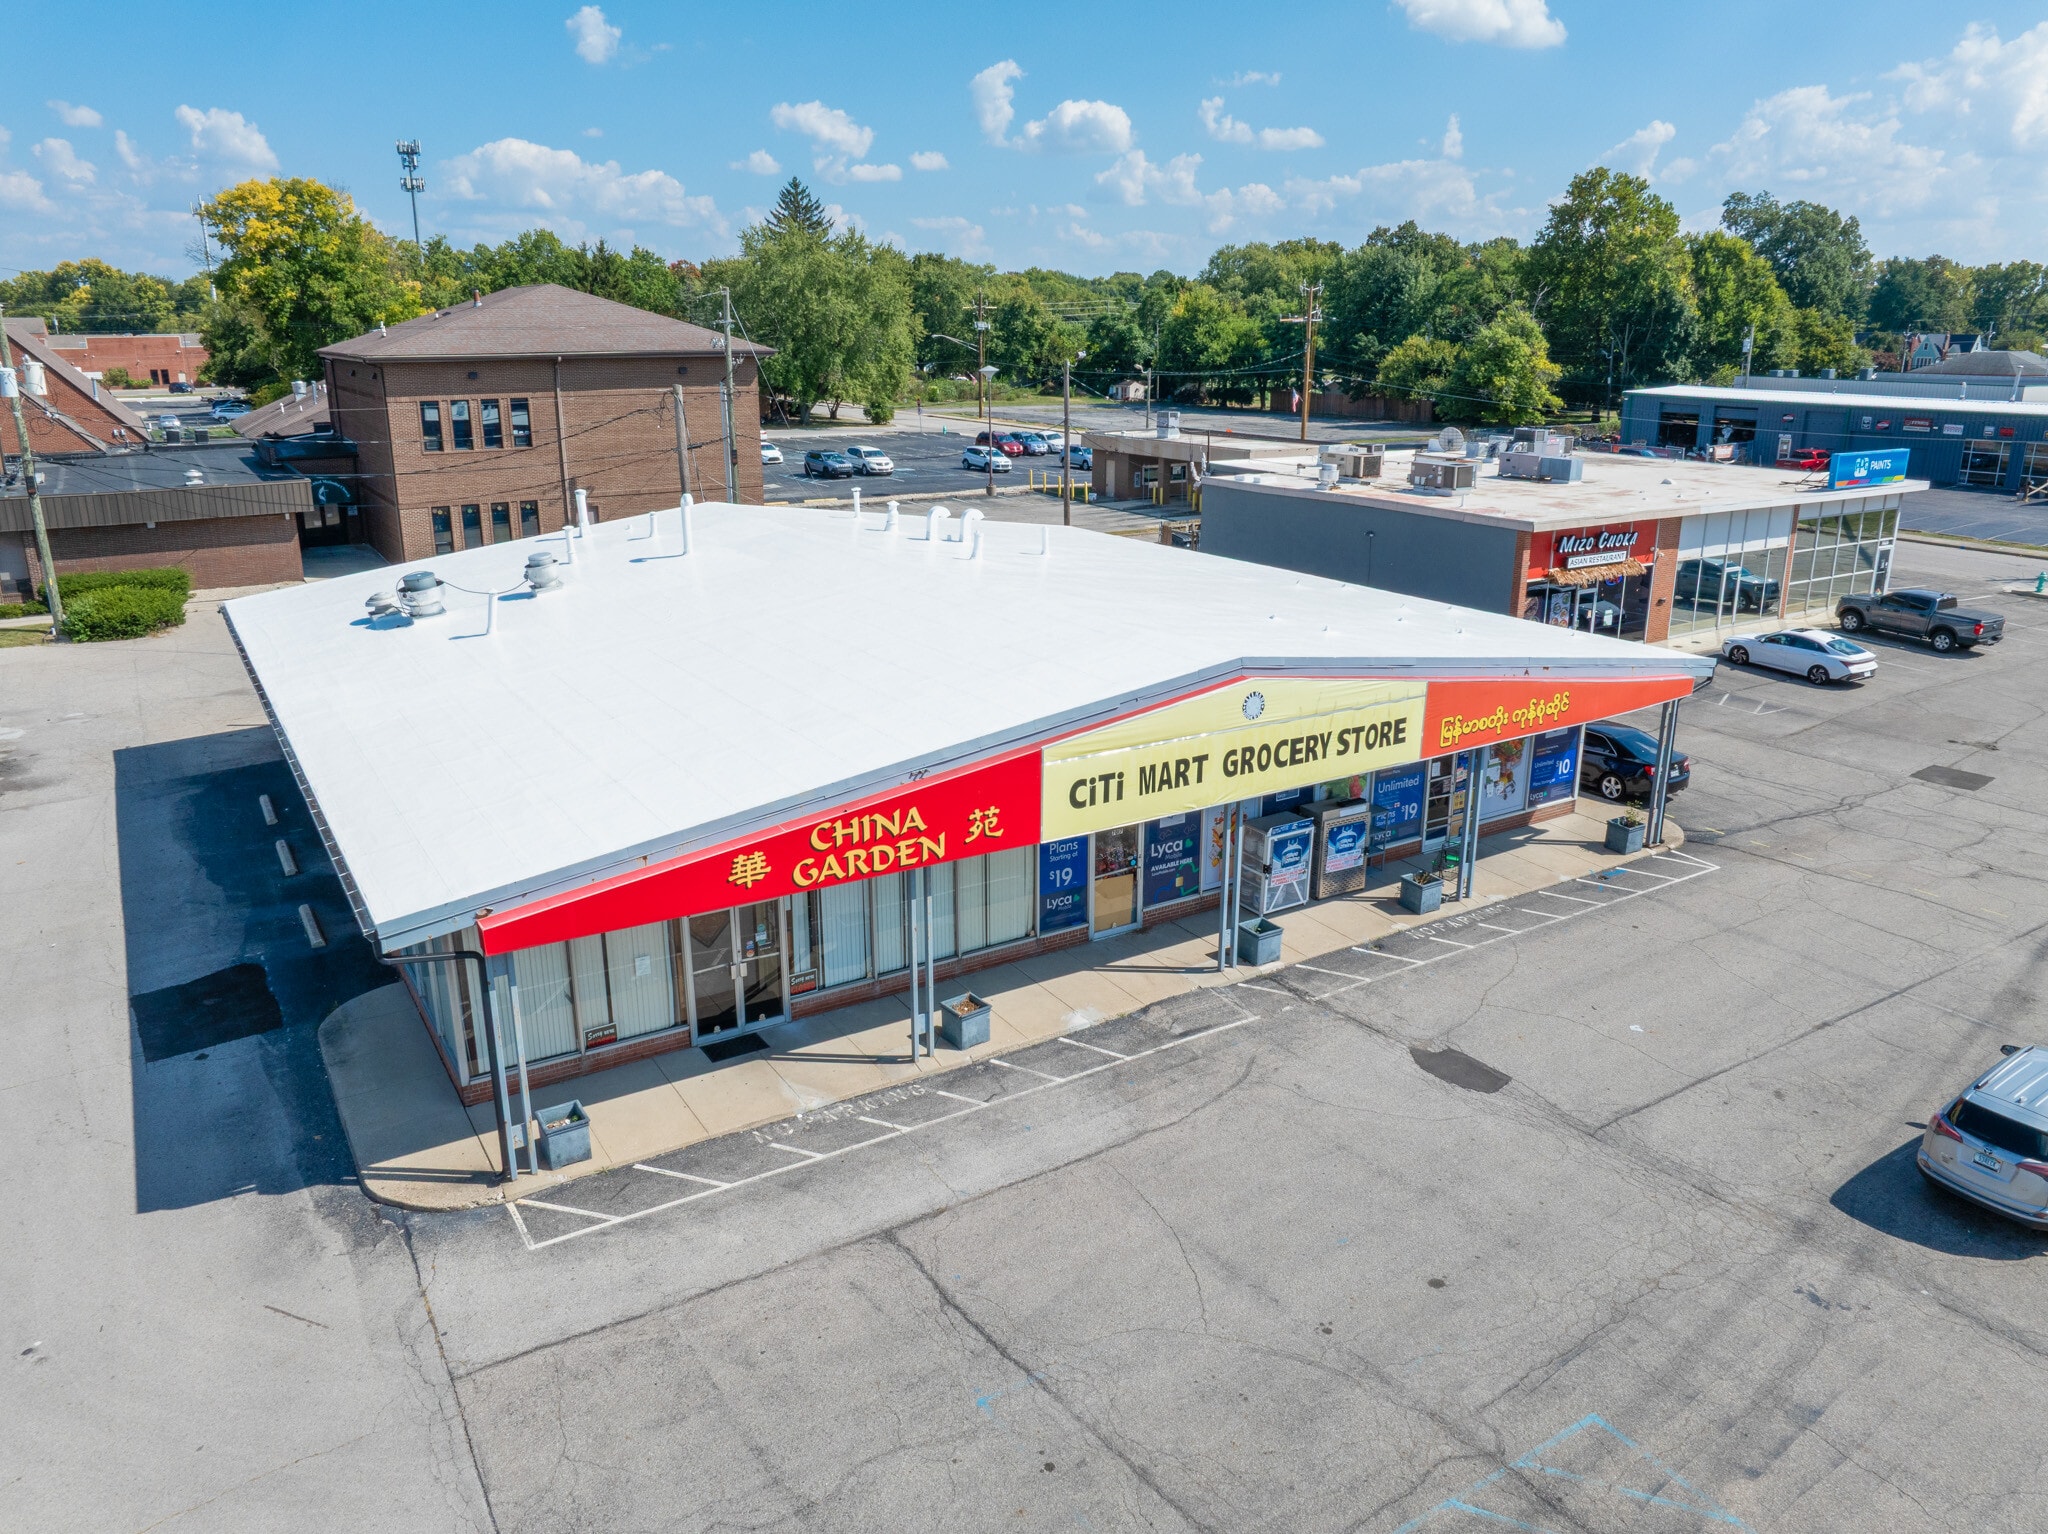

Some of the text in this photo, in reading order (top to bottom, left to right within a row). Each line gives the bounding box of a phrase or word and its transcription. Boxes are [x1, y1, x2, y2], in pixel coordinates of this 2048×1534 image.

[1870, 459, 1892, 471] PAINTS
[1569, 552, 1626, 567] ASIAN RESTAURANT
[1139, 753, 1209, 796] MART
[1223, 731, 1333, 777] GROCERY
[1337, 717, 1407, 756] STORE
[1378, 774, 1420, 793] Unlimited
[1401, 802, 1418, 820] $19
[810, 806, 928, 851] CHINA
[964, 805, 1004, 844] 苑
[1049, 841, 1079, 855] Plans
[1151, 839, 1183, 858] Lyca
[792, 831, 946, 887] GARDEN
[1049, 853, 1072, 863] Starting
[1150, 857, 1193, 872] AVAILABLE HERE
[727, 851, 771, 889] 華
[1049, 867, 1073, 888] $19
[1046, 894, 1073, 910] Lyca
